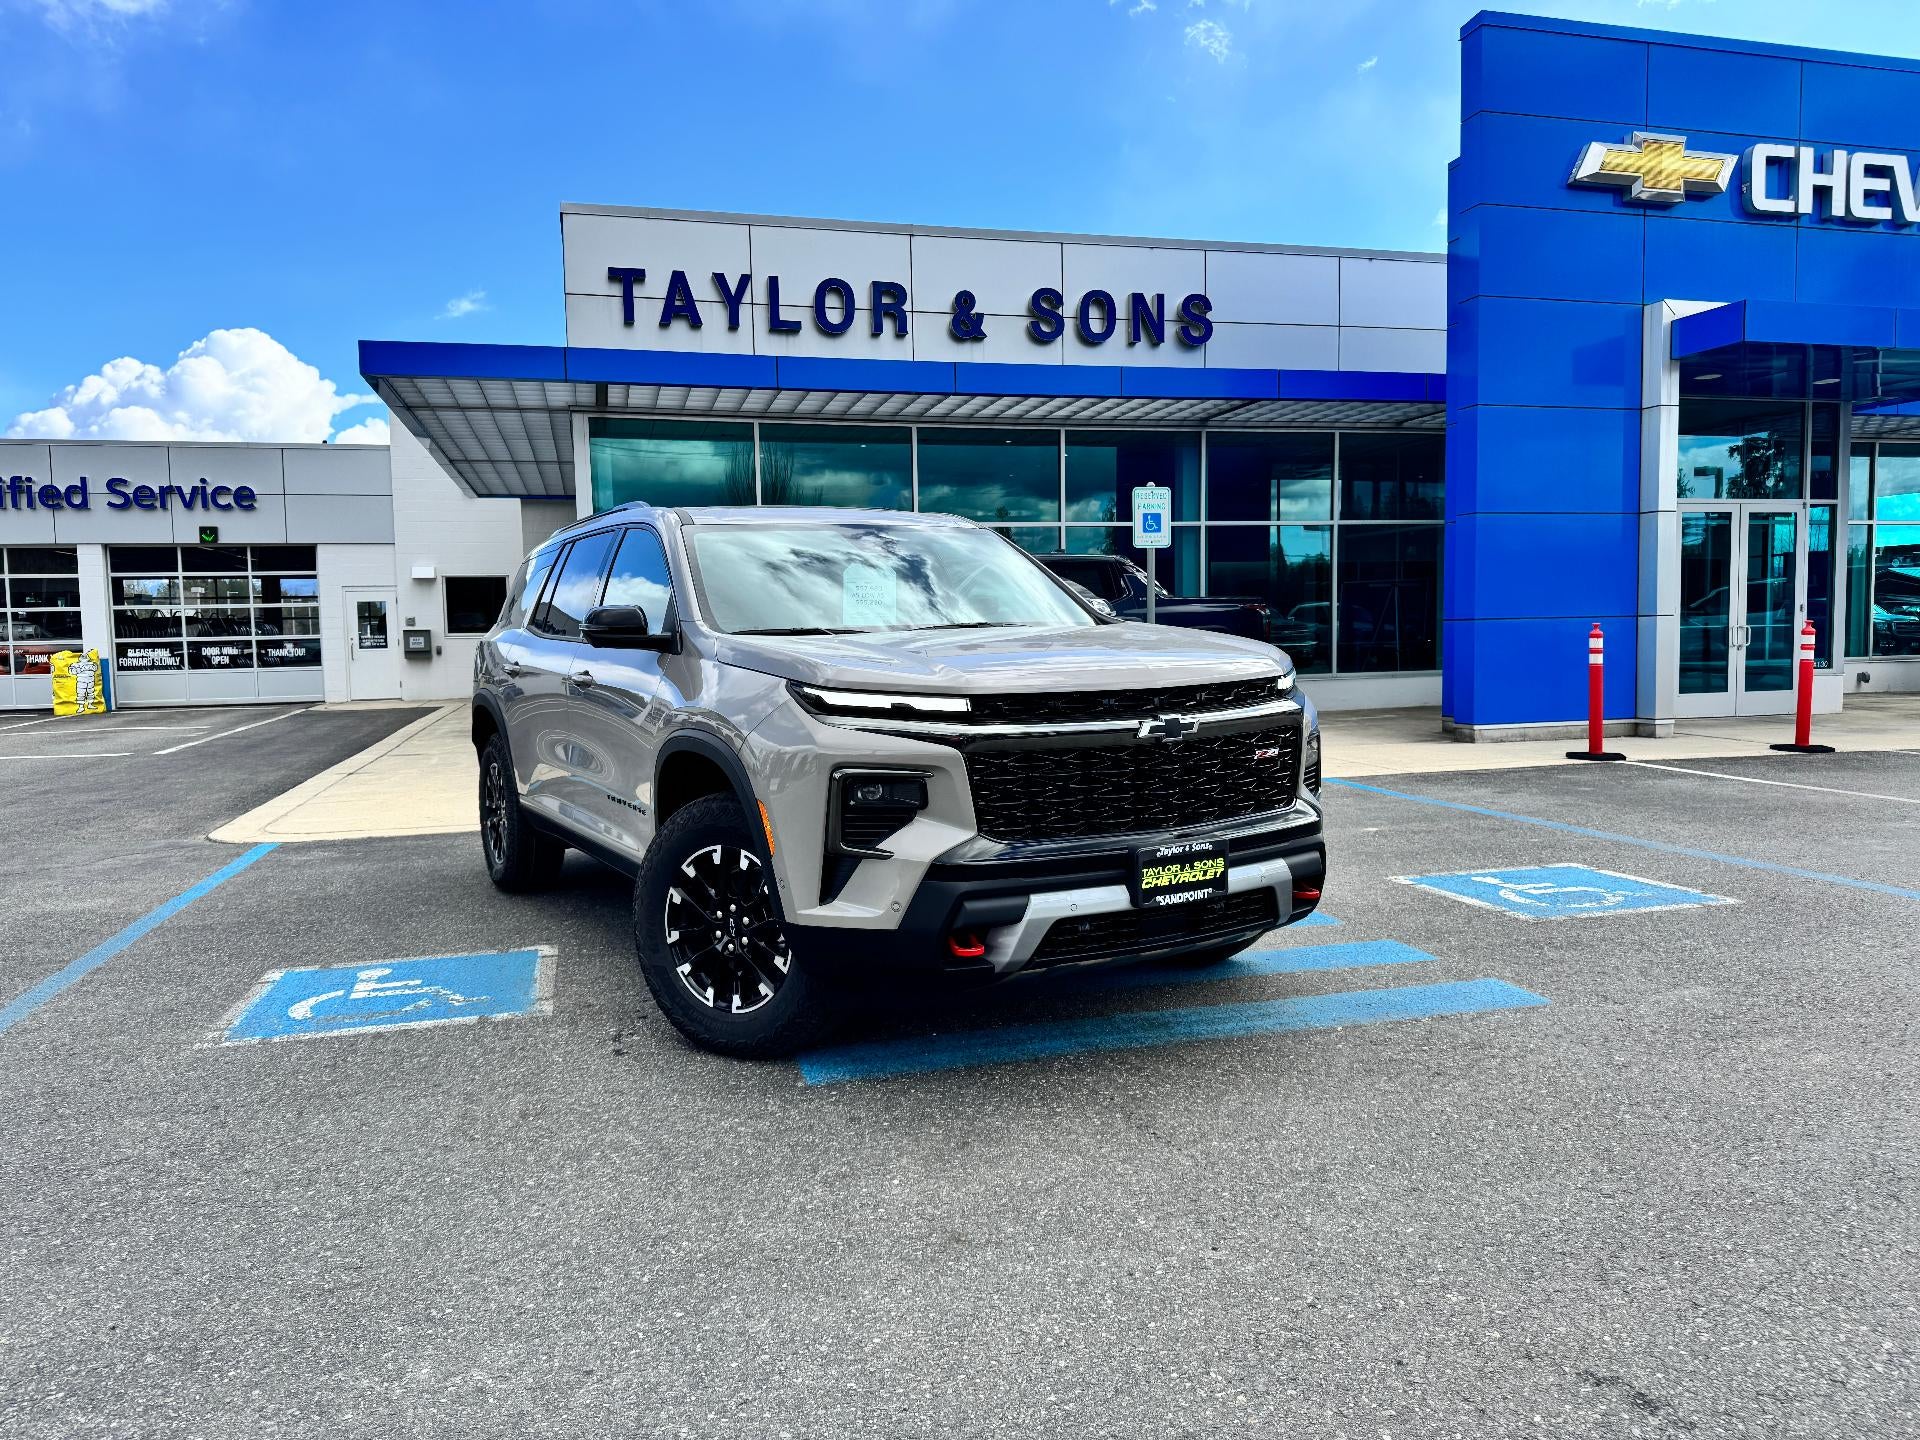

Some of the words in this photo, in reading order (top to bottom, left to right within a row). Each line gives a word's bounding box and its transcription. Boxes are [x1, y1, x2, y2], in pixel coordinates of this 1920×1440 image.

[607, 266, 910, 336] TAYLOR
[949, 290, 987, 341] &
[1028, 286, 1214, 346] SONS
[107, 478, 257, 510] Service
[1136, 492, 1167, 500] RESERVED
[1137, 502, 1166, 510] PARKING
[127, 649, 153, 657] PLEASE
[154, 648, 172, 656] PULL
[202, 647, 220, 656] DOOR
[221, 646, 239, 655] WILL
[267, 649, 289, 657] THANK
[290, 647, 306, 656] YOU!
[25, 654, 49, 663] THANK
[119, 657, 152, 667] FORWARD
[153, 656, 180, 666] SLOWLY
[211, 656, 229, 665] OPEN
[1159, 845, 1183, 857] Taylor
[1192, 842, 1209, 851] Sons
[1142, 864, 1180, 877] TAYLOR
[1184, 863, 1191, 872] &
[1194, 857, 1224, 868] SONS
[1141, 869, 1224, 889] CHEVROLET
[1159, 890, 1209, 906] SANDPOINT
